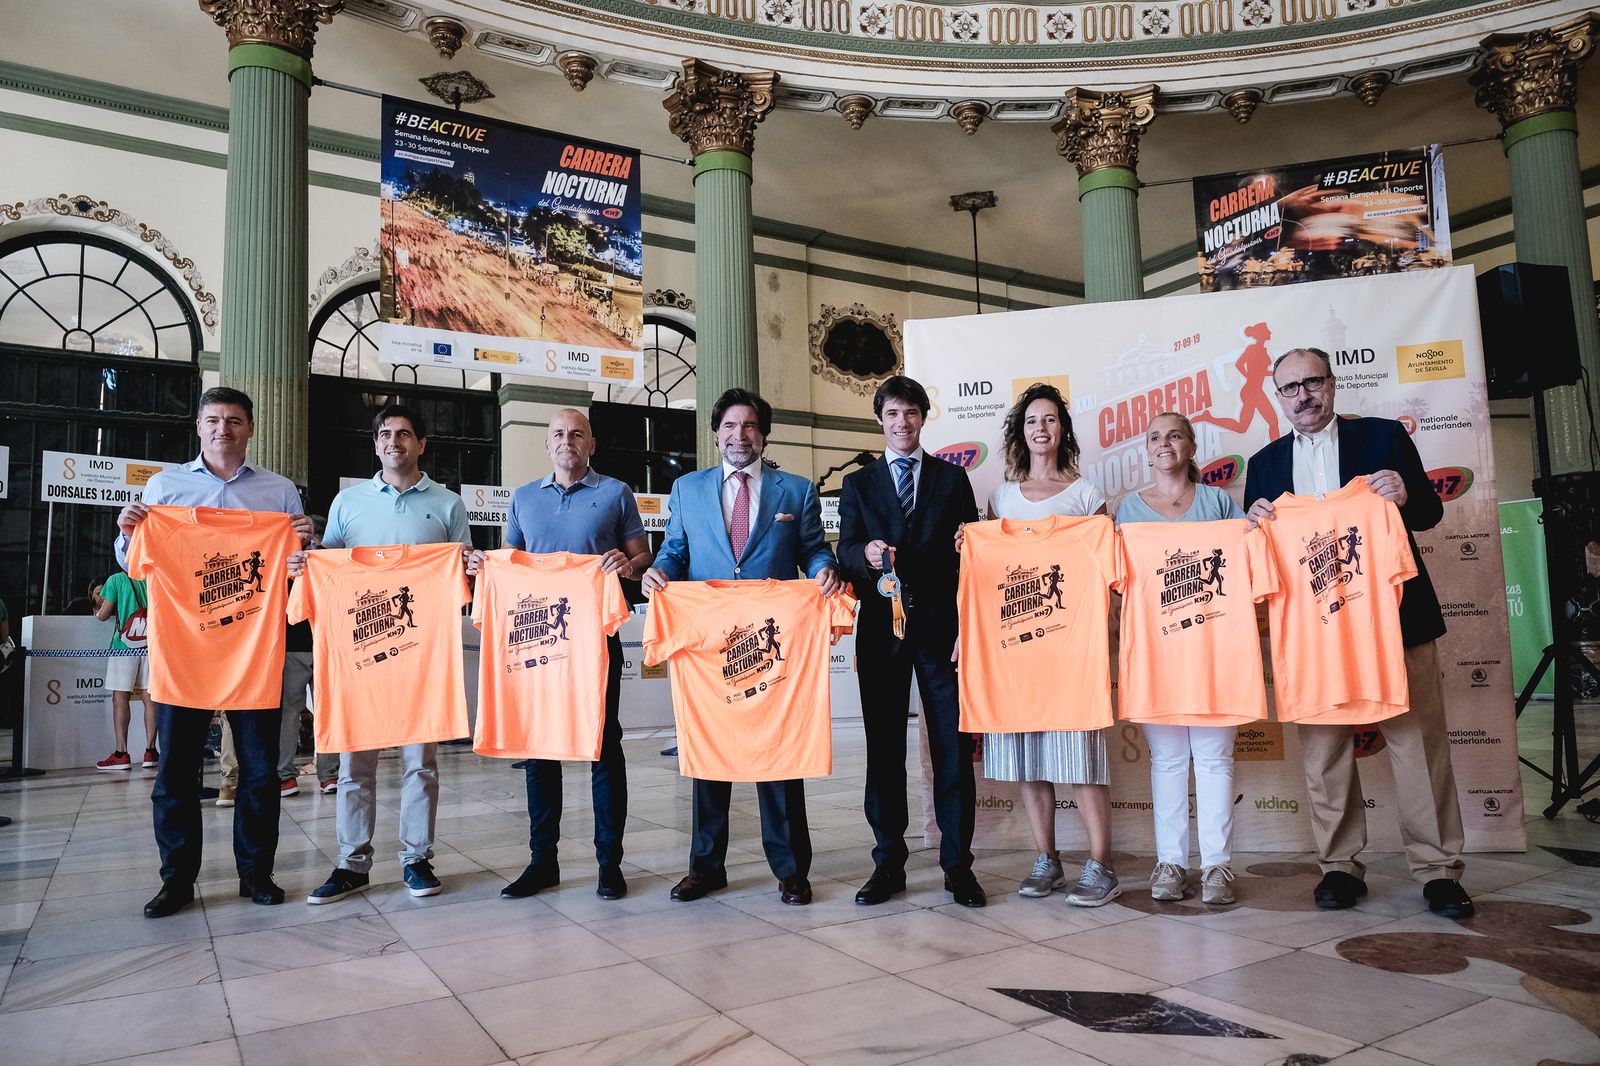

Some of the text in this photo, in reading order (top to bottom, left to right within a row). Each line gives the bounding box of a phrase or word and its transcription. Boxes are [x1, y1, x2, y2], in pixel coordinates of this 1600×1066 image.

[395, 111, 487, 142] #BEACTIVE
[394, 129, 490, 155] Semana Europea del Deporte
[417, 144, 452, 157] Septiembre
[560, 144, 633, 180] CARRERA
[1323, 160, 1423, 187] #BEACTIVE
[541, 170, 628, 208] NOCTURNA
[1209, 175, 1275, 222] CARRERA
[1320, 183, 1424, 204] Semana Europea del Deporte
[1387, 194, 1426, 205] Septiembre
[1203, 202, 1281, 253] NOCTURNA
[567, 350, 591, 363] IMD
[1335, 347, 1376, 367] IMD
[1334, 371, 1390, 383] tituto Municipal
[1346, 380, 1379, 391] Deportes
[958, 380, 993, 398] IMD
[947, 401, 1005, 414] Instituto Municipal
[957, 411, 997, 421] de Deportes
[1098, 369, 1213, 449] CARRERA
[1420, 414, 1459, 425] nationale
[1420, 420, 1473, 432] nederlanden
[89, 459, 114, 471] IMD
[48, 483, 98, 500] DORSALES
[100, 488, 131, 503] 12.001
[492, 489, 511, 498] IMD
[501, 512, 509, 523] 8.
[643, 518, 650, 527] al
[822, 520, 834, 529] LES
[203, 564, 241, 588] CARRERA
[1163, 562, 1201, 587] CARRERA
[199, 581, 244, 606] NOCTURNA
[1004, 578, 1041, 602] CARRERA
[1160, 580, 1204, 606] NOCTURNA
[355, 600, 392, 625] CARRERA
[1000, 595, 1043, 620] NOCTURNA
[1441, 609, 1489, 618] ederlanden
[513, 608, 549, 628] CARRERA
[352, 616, 396, 643] NOCTURNA
[508, 624, 550, 645] NOCTURNA
[726, 634, 760, 663] CARRERA
[830, 654, 846, 663] MD
[722, 650, 764, 679] NOCTURNA
[76, 677, 104, 689] IMD
[1446, 728, 1487, 737] nationale
[974, 795, 1015, 813] viding
[1111, 800, 1153, 812] uzcampo
[1254, 795, 1300, 814] viding
